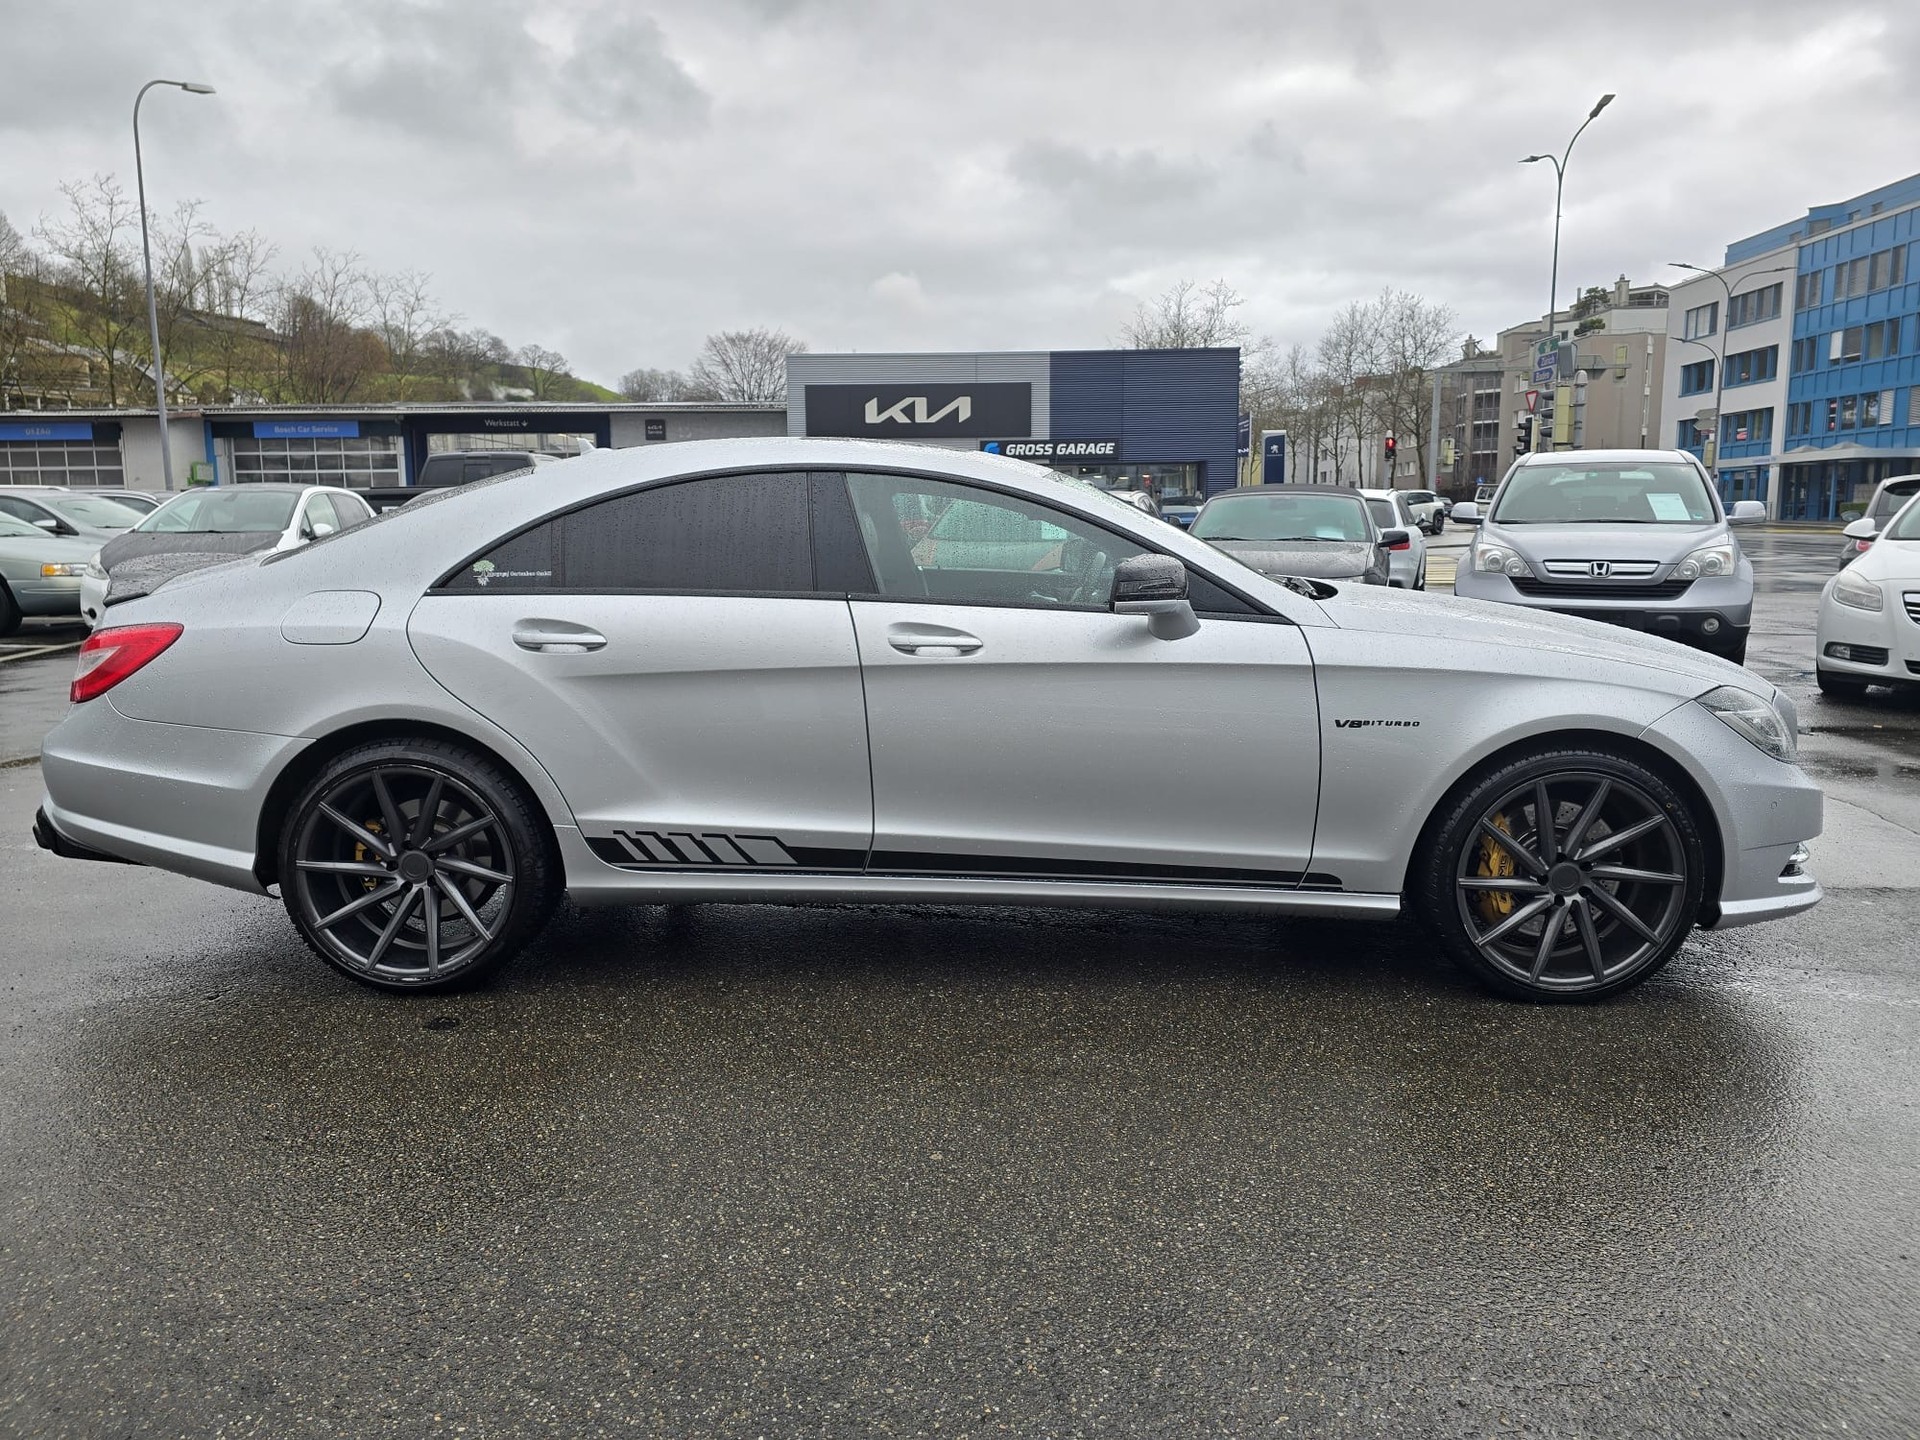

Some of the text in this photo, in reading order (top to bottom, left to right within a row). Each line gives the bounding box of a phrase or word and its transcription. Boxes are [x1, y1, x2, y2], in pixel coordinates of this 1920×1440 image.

[865, 396, 971, 423] KIA
[485, 419, 520, 427] Werkstatt
[274, 425, 338, 433] Bosch Car Service
[1005, 443, 1115, 456] GROSS GARAGE
